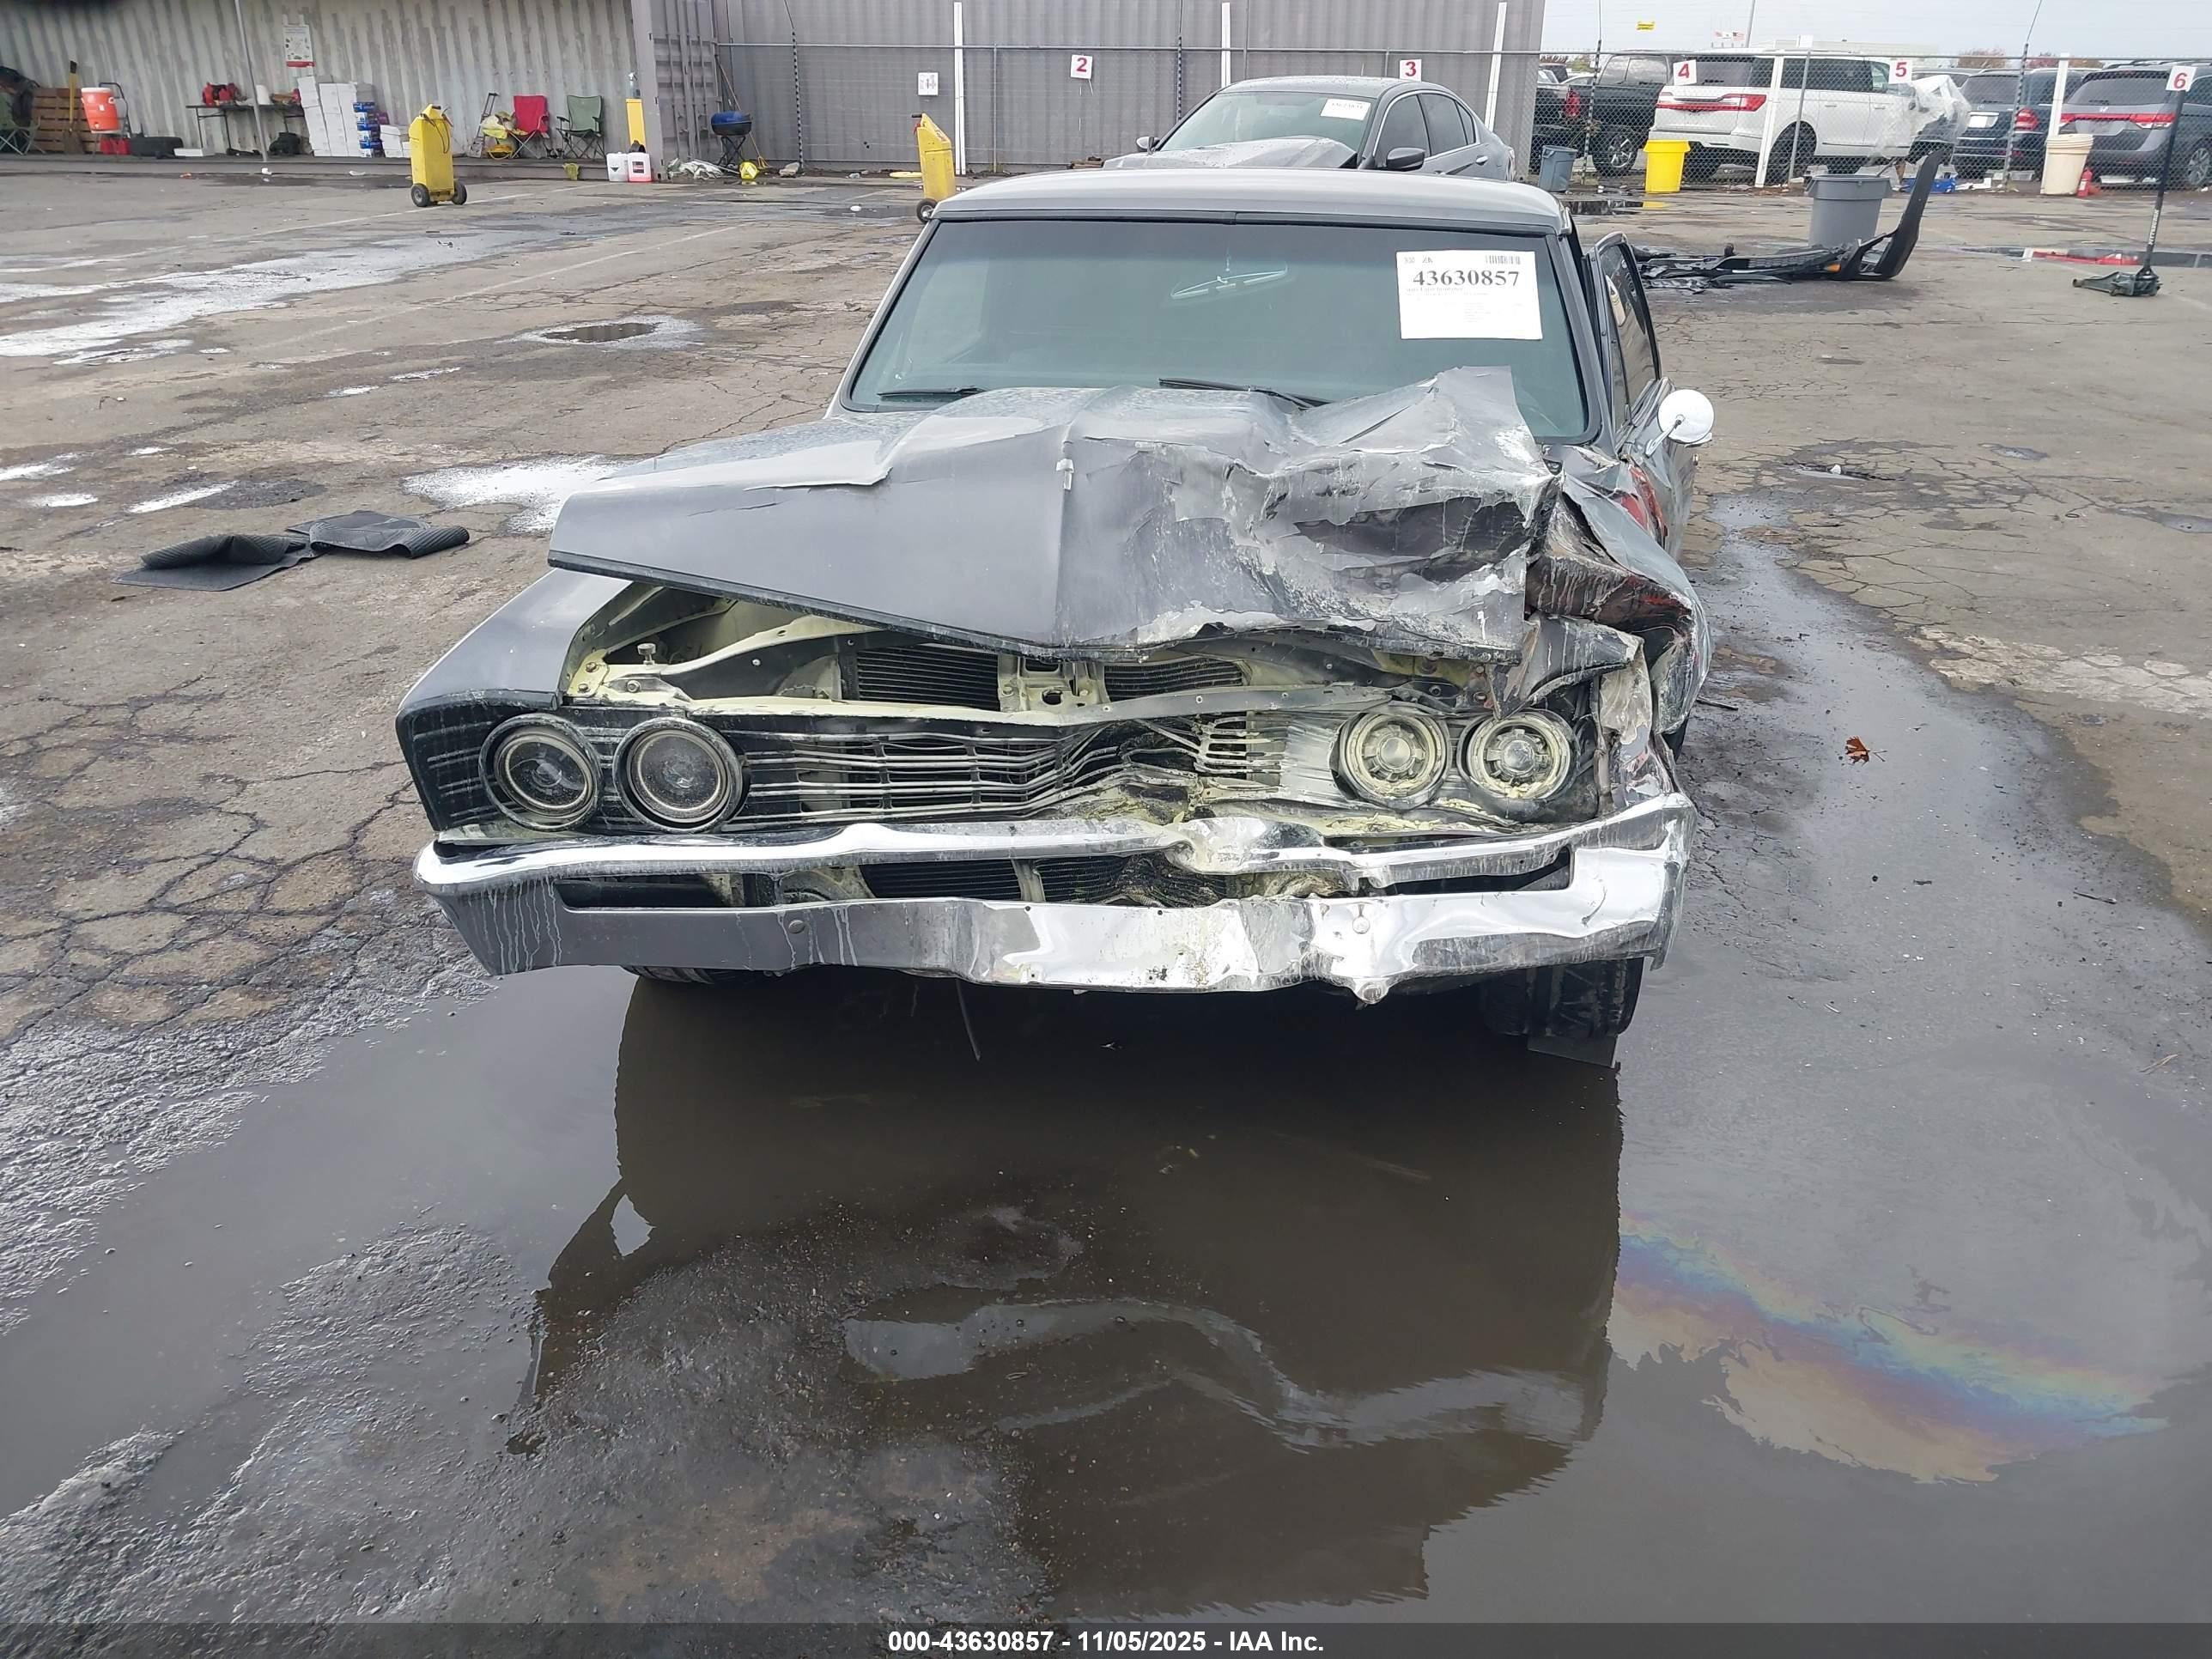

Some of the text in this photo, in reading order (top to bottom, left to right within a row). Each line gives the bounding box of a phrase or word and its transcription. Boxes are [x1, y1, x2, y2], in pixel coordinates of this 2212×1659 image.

[1077, 58, 1087, 72] 2
[1405, 61, 1417, 76] 3
[1678, 64, 1690, 78] 4
[1895, 62, 1907, 76] 5
[2173, 73, 2187, 88] 6
[1413, 270, 1519, 287] 43630857
